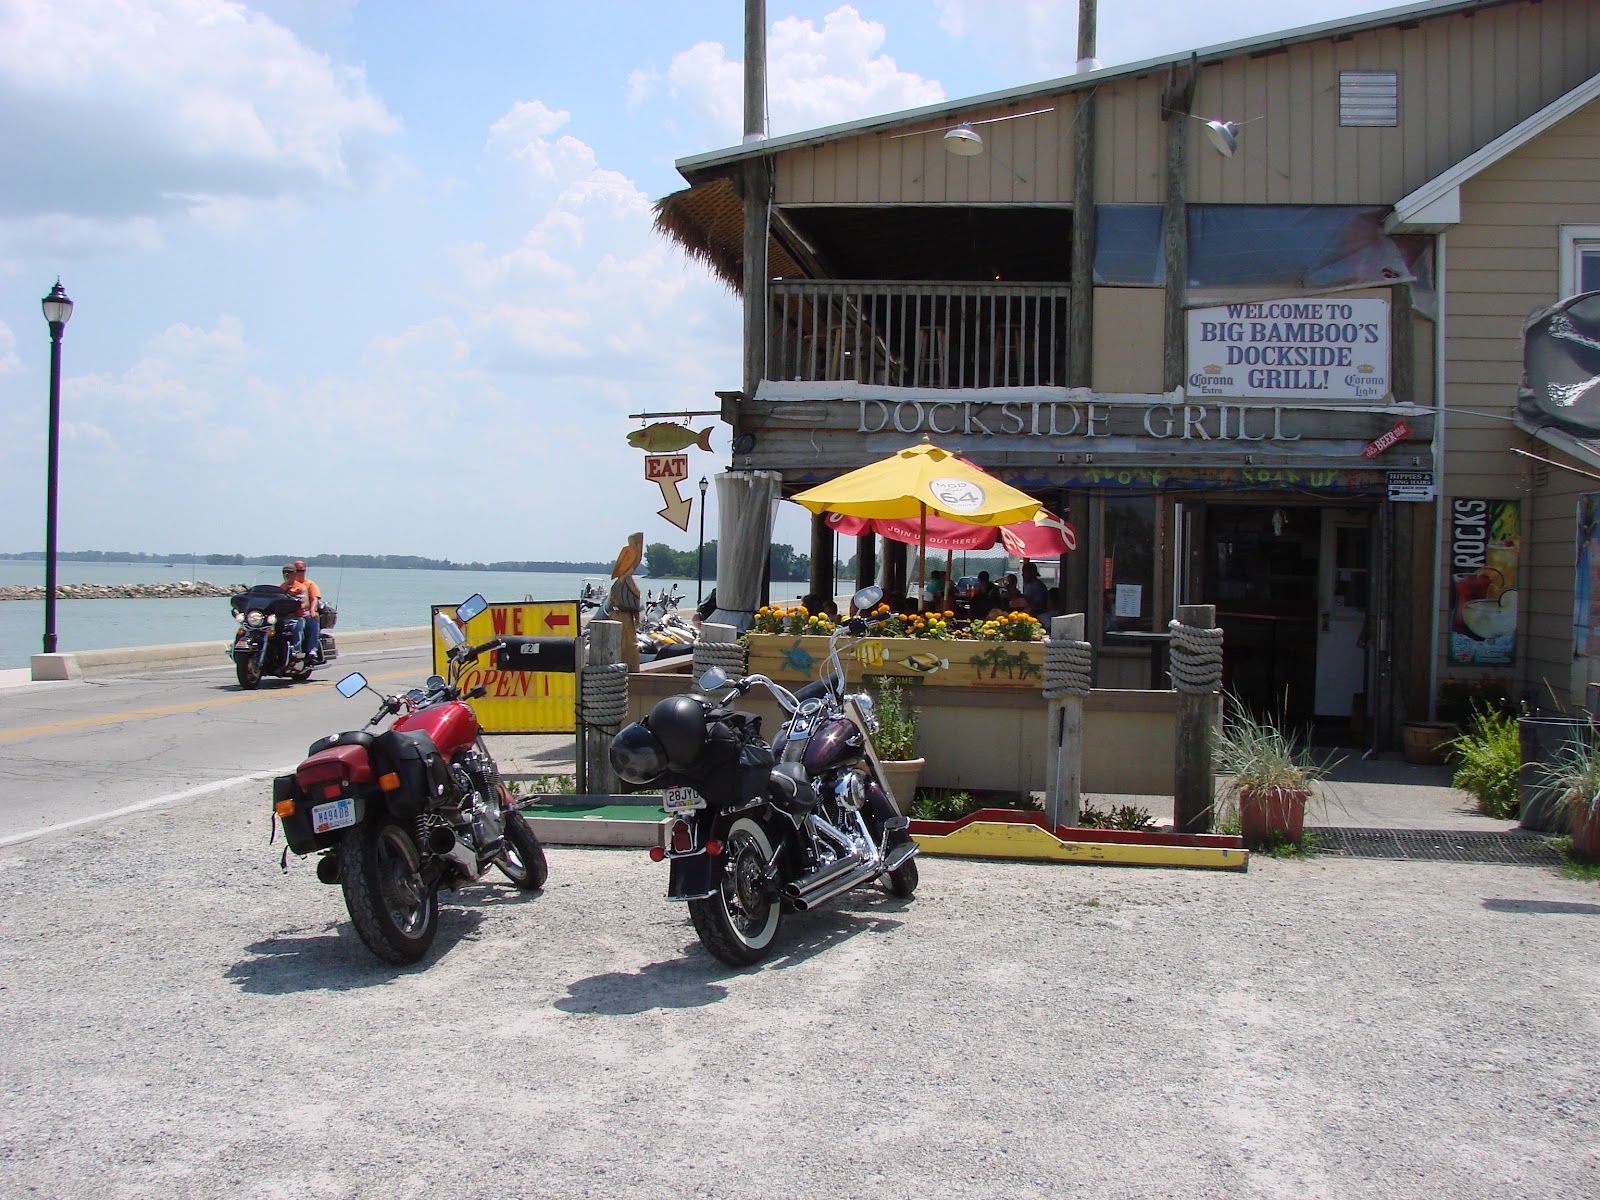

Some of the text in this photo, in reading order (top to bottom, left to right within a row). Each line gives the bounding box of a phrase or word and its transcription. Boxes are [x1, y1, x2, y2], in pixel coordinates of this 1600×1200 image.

[1227, 304, 1352, 319] WELCOME TO
[1200, 322, 1379, 343] BIG BAMBOO'S
[1226, 345, 1352, 366] DOCKSIDE
[1188, 373, 1234, 388] Corona
[1247, 369, 1329, 390] GRILL!
[1344, 374, 1384, 387] Corona
[1355, 386, 1377, 397] Light
[857, 399, 1301, 442] DOCKSIDE GRILL
[1375, 431, 1397, 451] BEER
[648, 458, 686, 477] EAT
[939, 491, 979, 504] 64
[887, 526, 911, 538] JOIN
[1453, 500, 1487, 568] ROCKS
[491, 608, 523, 636] WE
[463, 669, 533, 697] OPEN
